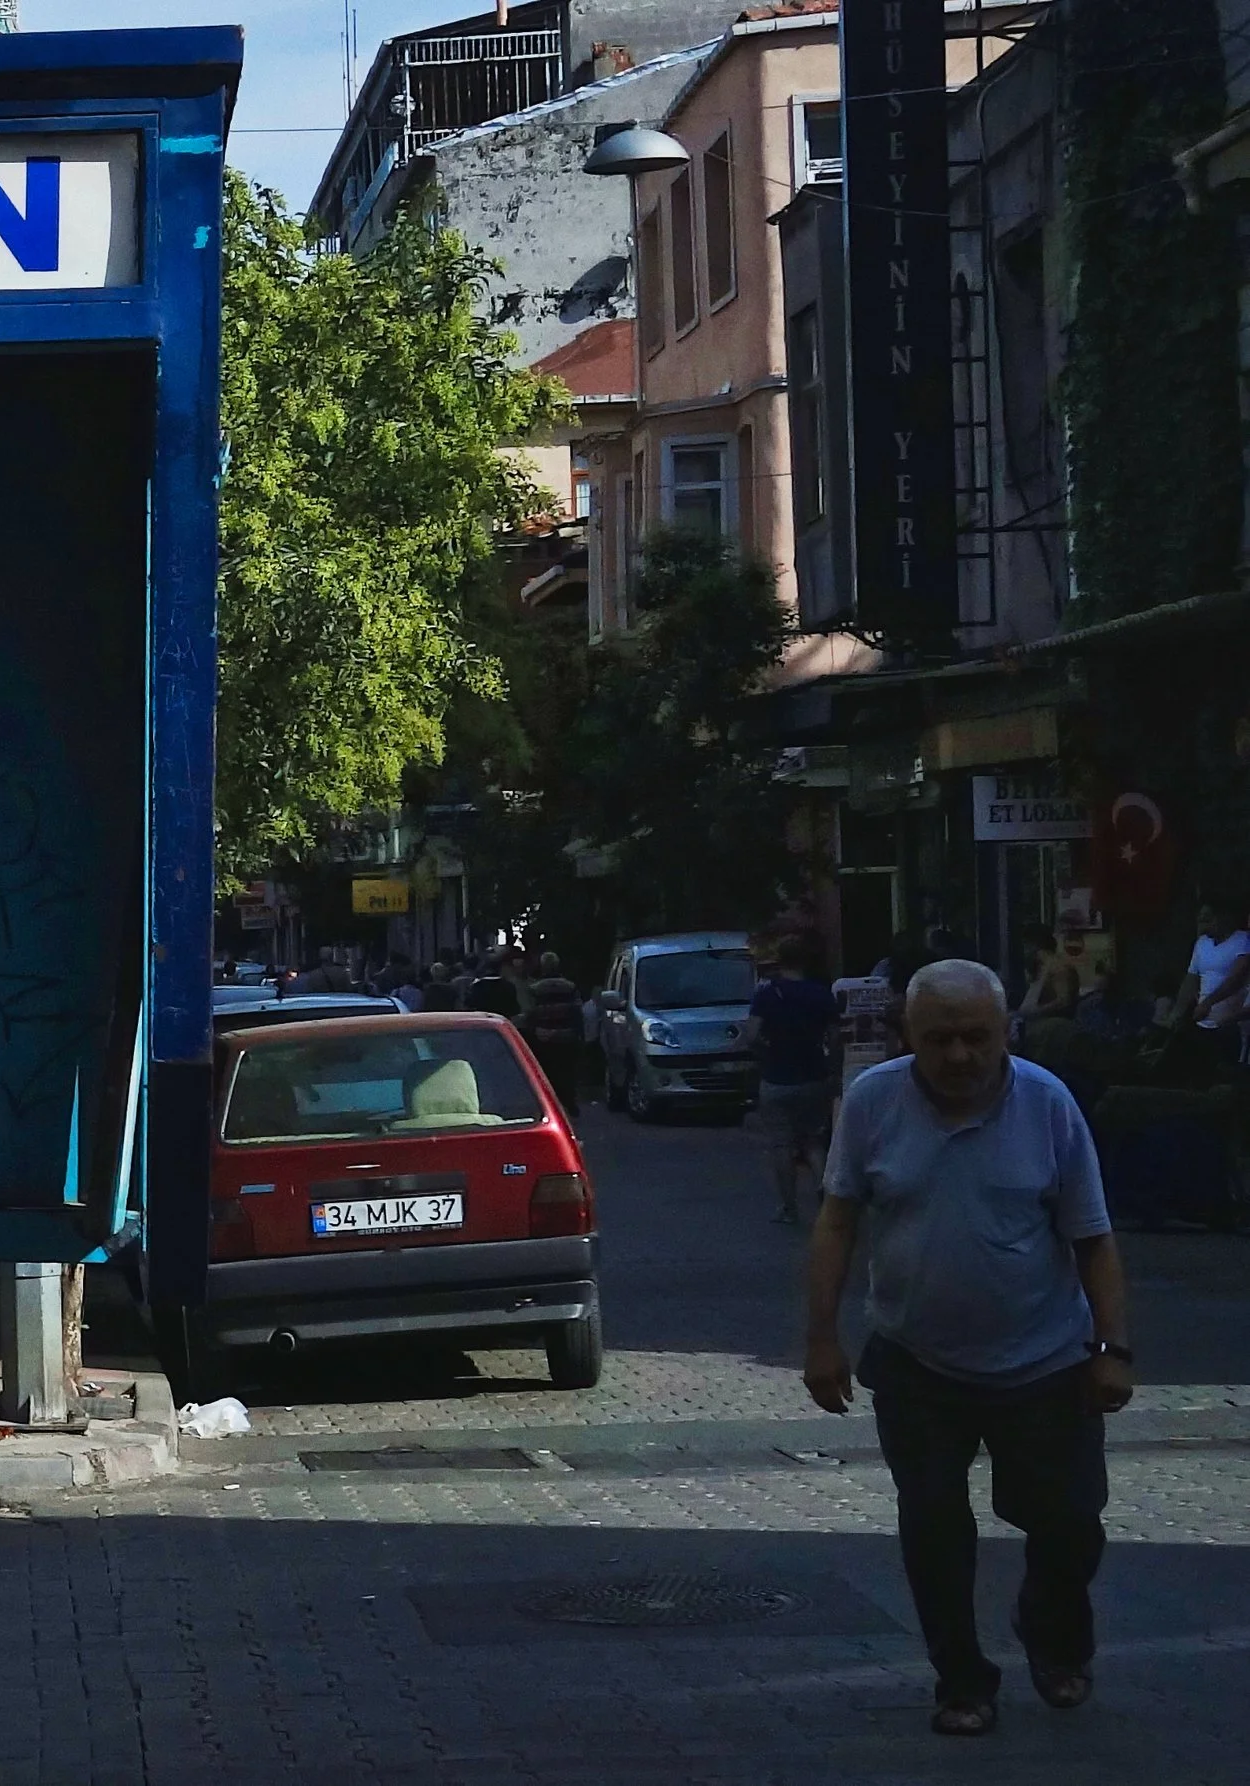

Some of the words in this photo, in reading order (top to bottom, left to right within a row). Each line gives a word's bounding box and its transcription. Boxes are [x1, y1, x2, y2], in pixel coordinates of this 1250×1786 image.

[893, 430, 916, 589] YERİ
[988, 804, 1015, 823] ET
[328, 1205, 357, 1227] 34
[367, 1200, 418, 1226] MJK
[428, 1198, 456, 1221] 37
